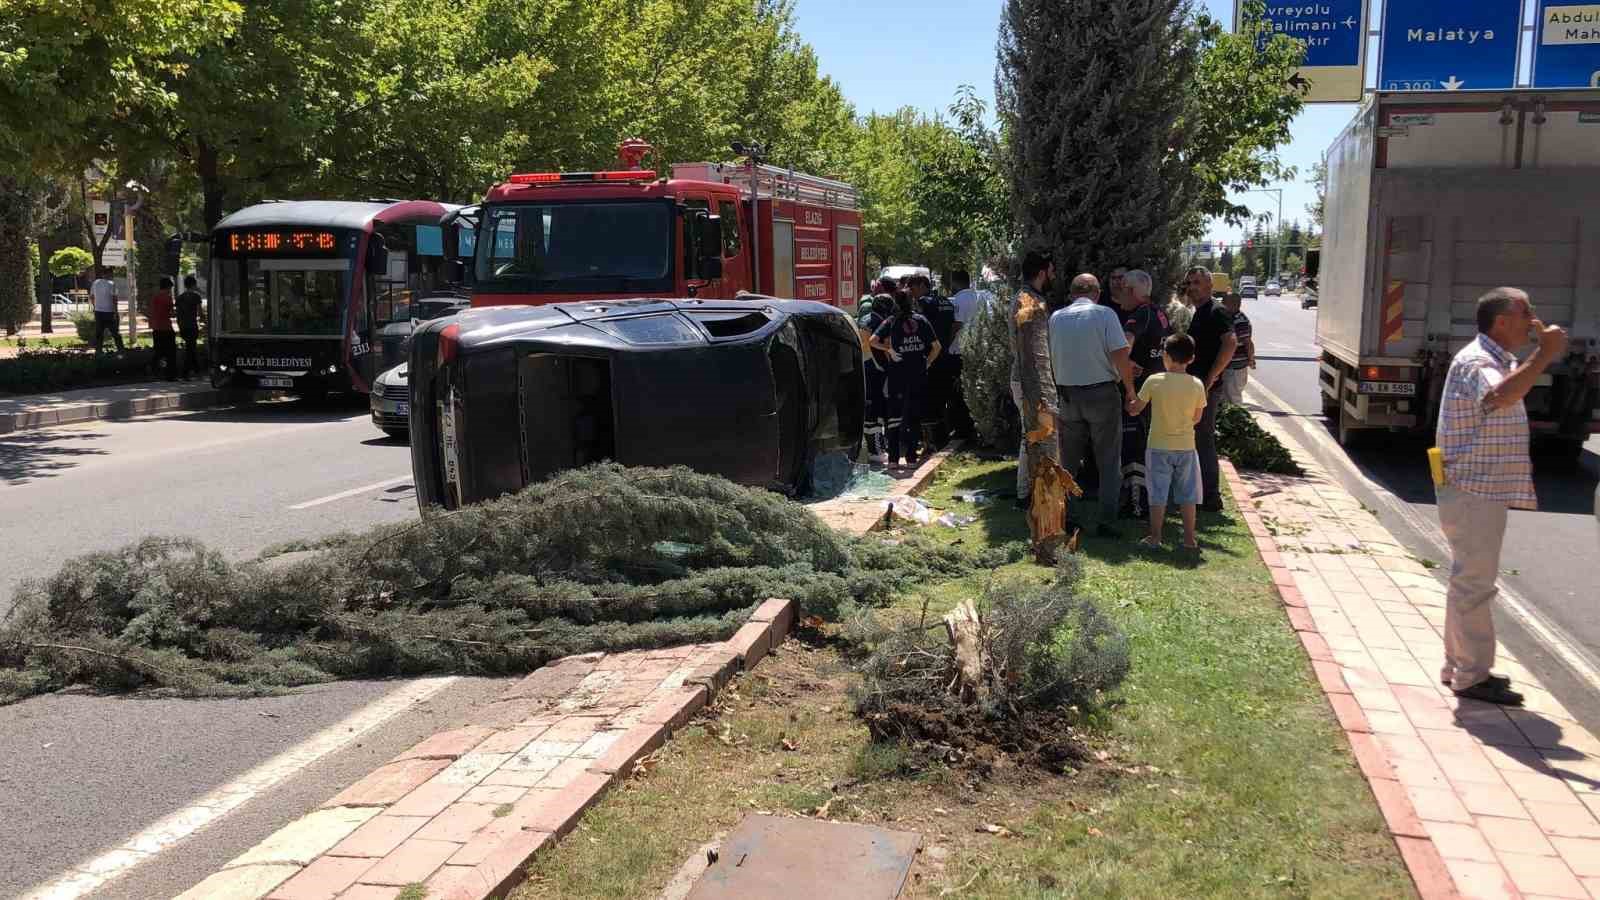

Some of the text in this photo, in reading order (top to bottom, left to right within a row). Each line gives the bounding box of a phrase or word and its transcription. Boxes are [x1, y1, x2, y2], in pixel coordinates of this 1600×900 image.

[1267, 3, 1330, 18] vreyolu
[1270, 20, 1337, 32] alimanı
[1407, 28, 1495, 44] Malatya
